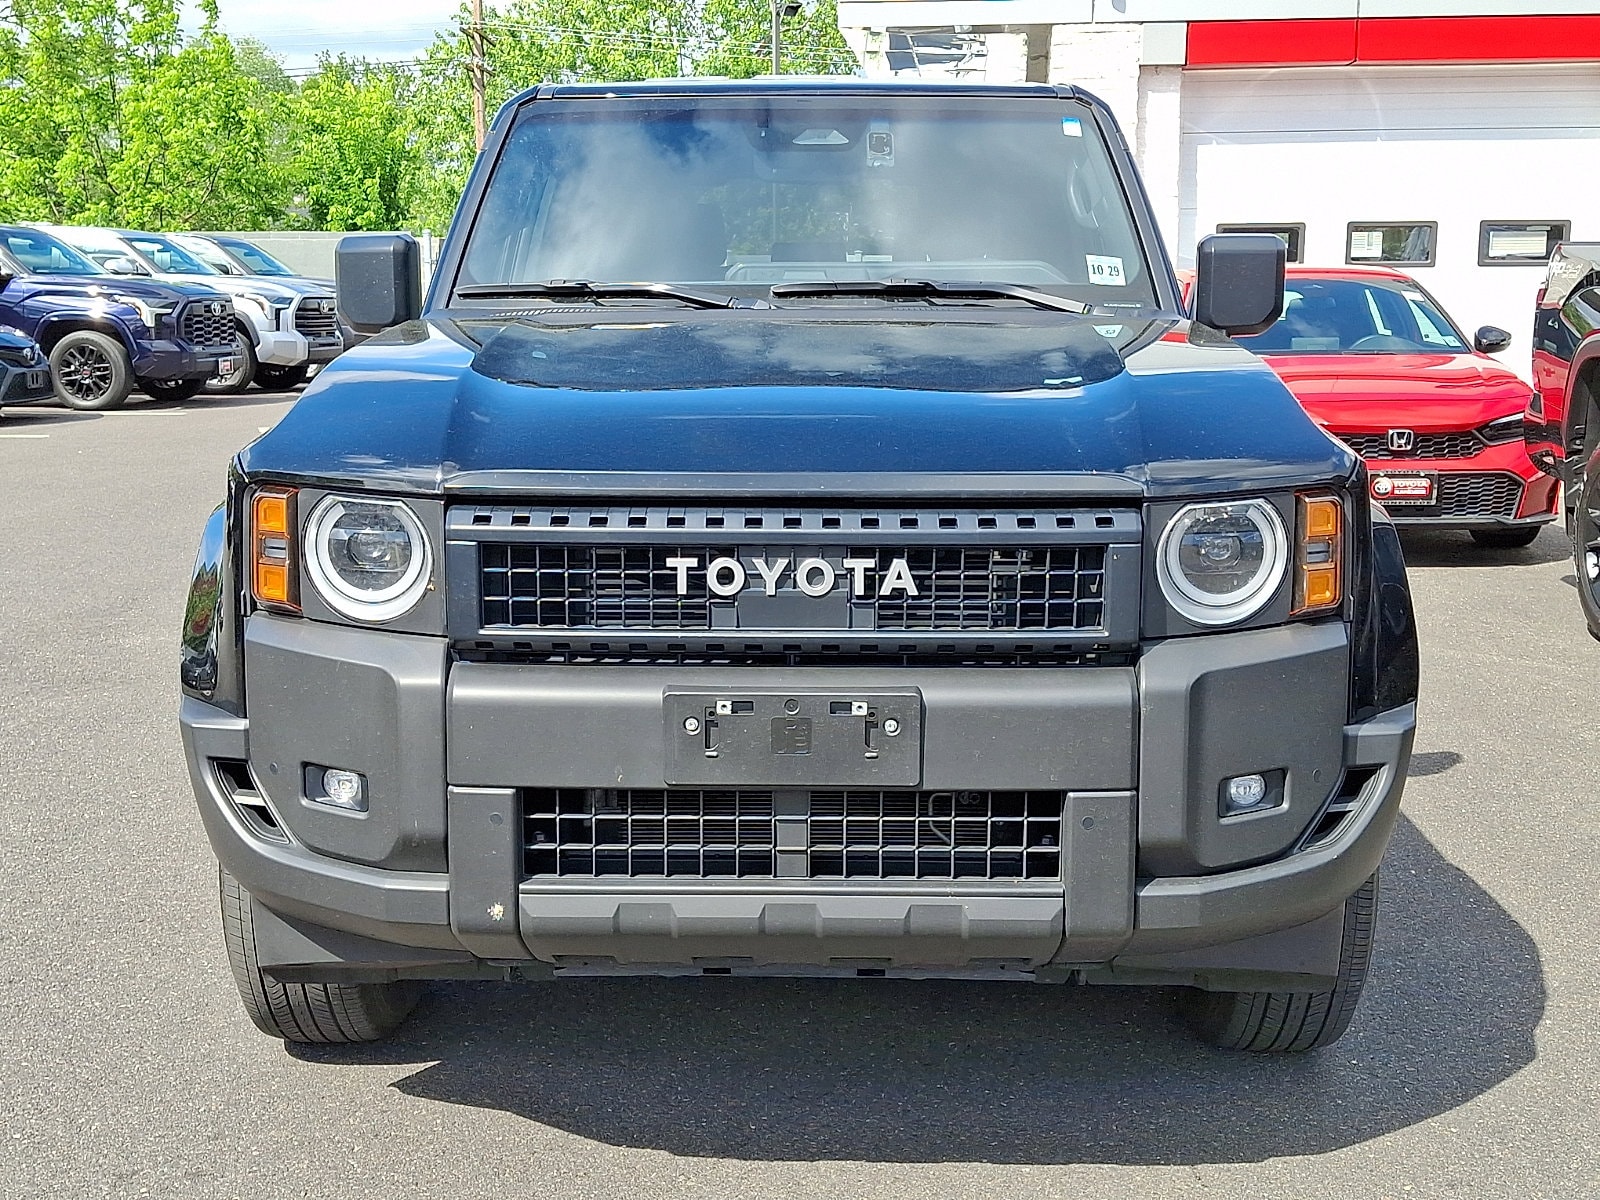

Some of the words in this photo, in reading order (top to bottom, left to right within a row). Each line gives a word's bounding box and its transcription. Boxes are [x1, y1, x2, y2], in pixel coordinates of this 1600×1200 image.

[1091, 264, 1104, 275] 10
[1107, 265, 1120, 277] 29
[666, 557, 919, 596] TOYOTA
